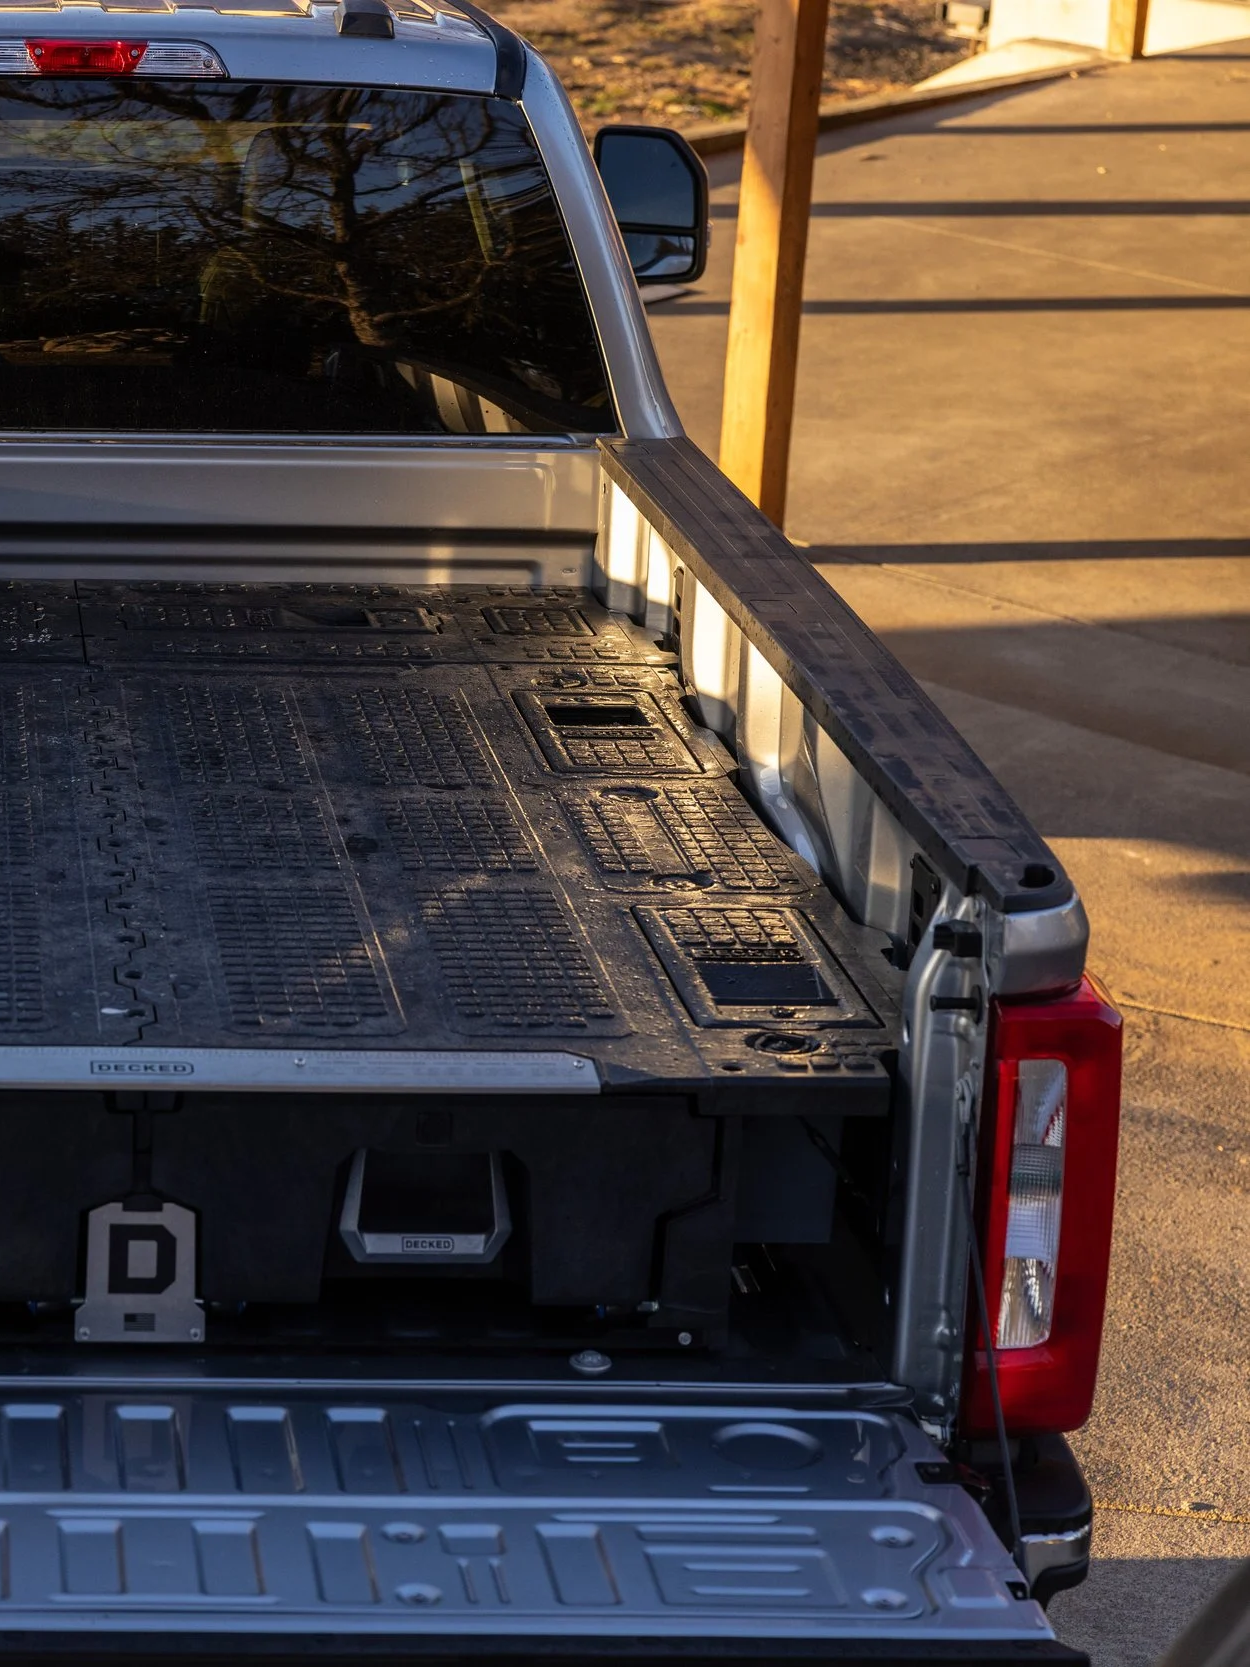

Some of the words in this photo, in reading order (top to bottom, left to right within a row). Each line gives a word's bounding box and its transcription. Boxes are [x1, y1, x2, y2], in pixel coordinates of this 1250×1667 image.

[97, 1063, 187, 1073] DECKED
[405, 1239, 451, 1250] DECKED
[108, 1223, 177, 1294] D
